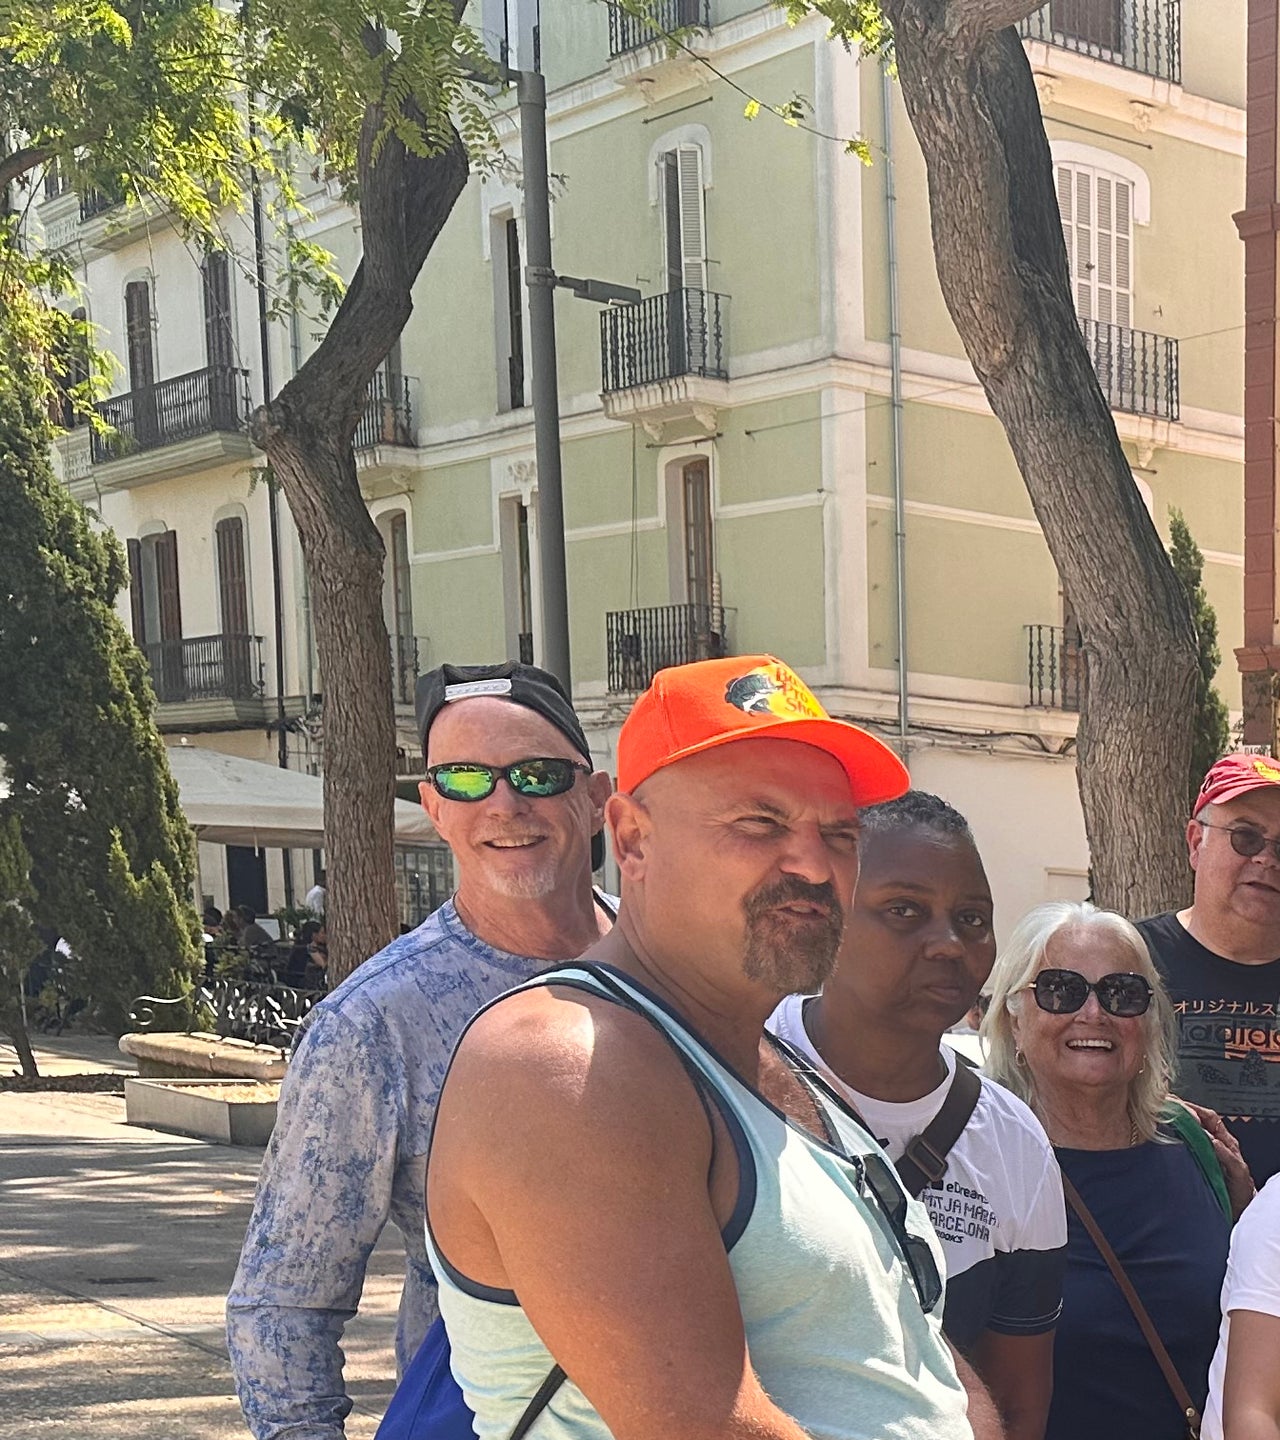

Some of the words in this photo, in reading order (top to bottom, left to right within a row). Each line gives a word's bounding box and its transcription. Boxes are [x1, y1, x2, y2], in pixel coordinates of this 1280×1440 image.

[1174, 998, 1277, 1016] オリジナルス
[930, 1211, 990, 1242] ARCELONA
